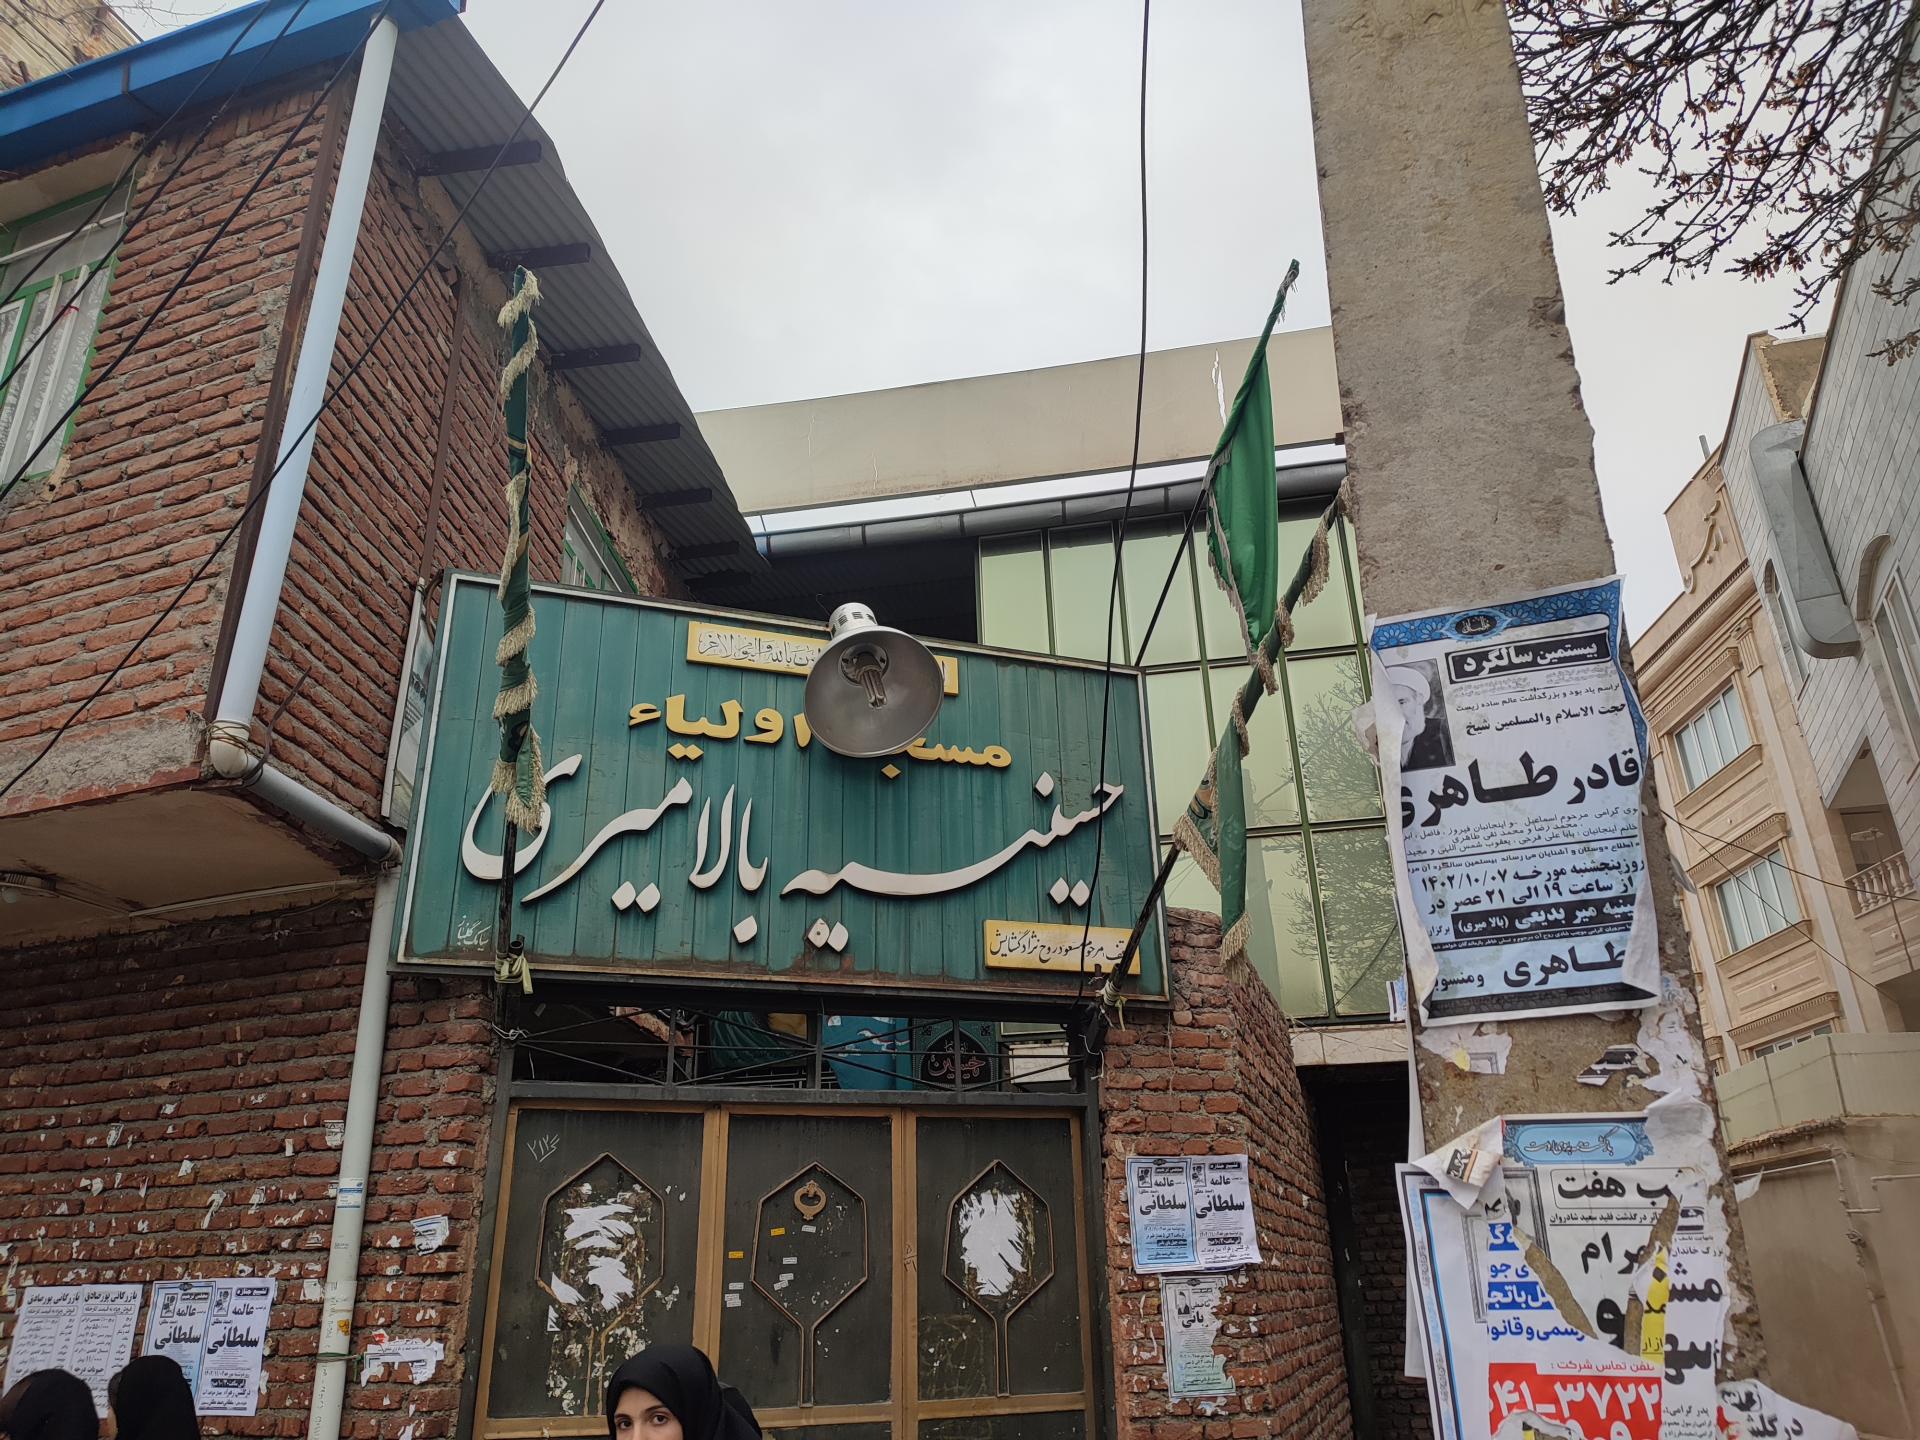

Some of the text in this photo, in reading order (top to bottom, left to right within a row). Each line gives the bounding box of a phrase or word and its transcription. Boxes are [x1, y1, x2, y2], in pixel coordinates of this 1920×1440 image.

[1463, 647, 1534, 677] سالگرد
[1536, 642, 1599, 665] بیستمین
[1481, 700, 1500, 708] ساده
[1518, 691, 1561, 704] بزرگداشت
[1555, 706, 1594, 723] الاسلام
[1598, 702, 1627, 717] حجت
[1465, 719, 1491, 736] شیخ
[1401, 747, 1640, 829] قادر طاهری
[1524, 814, 1558, 827] اسماعیل
[1560, 813, 1589, 824] مرحوم
[1594, 806, 1620, 819] گرامی
[1451, 833, 1481, 845] طاهری
[461, 754, 1124, 952] حسینیه بالا میری
[1421, 858, 1645, 893] روز پنجشنبه مورخه ۱۴۰۲/۱۰/۰۷
[1427, 876, 1635, 916] از ساعت ۱۹ الی ۲۱ عصر در
[1515, 906, 1567, 930] بدیعی
[1572, 906, 1598, 924] میر
[1503, 941, 1627, 988] طاهری
[1557, 1170, 1626, 1199] هفت
[1139, 1194, 1187, 1216] سلطانی
[1195, 1194, 1245, 1219] سلطانی
[1550, 1212, 1579, 1223] شادروان
[1579, 1213, 1598, 1222] سعید
[1599, 1213, 1614, 1222] فقید
[175, 1304, 197, 1317] عالمه
[231, 1303, 255, 1316] عالمه
[154, 1325, 202, 1350] سلطانی
[206, 1326, 260, 1355] سلطانی
[1557, 1359, 1593, 1373] شرکت
[1595, 1360, 1627, 1372] تماس
